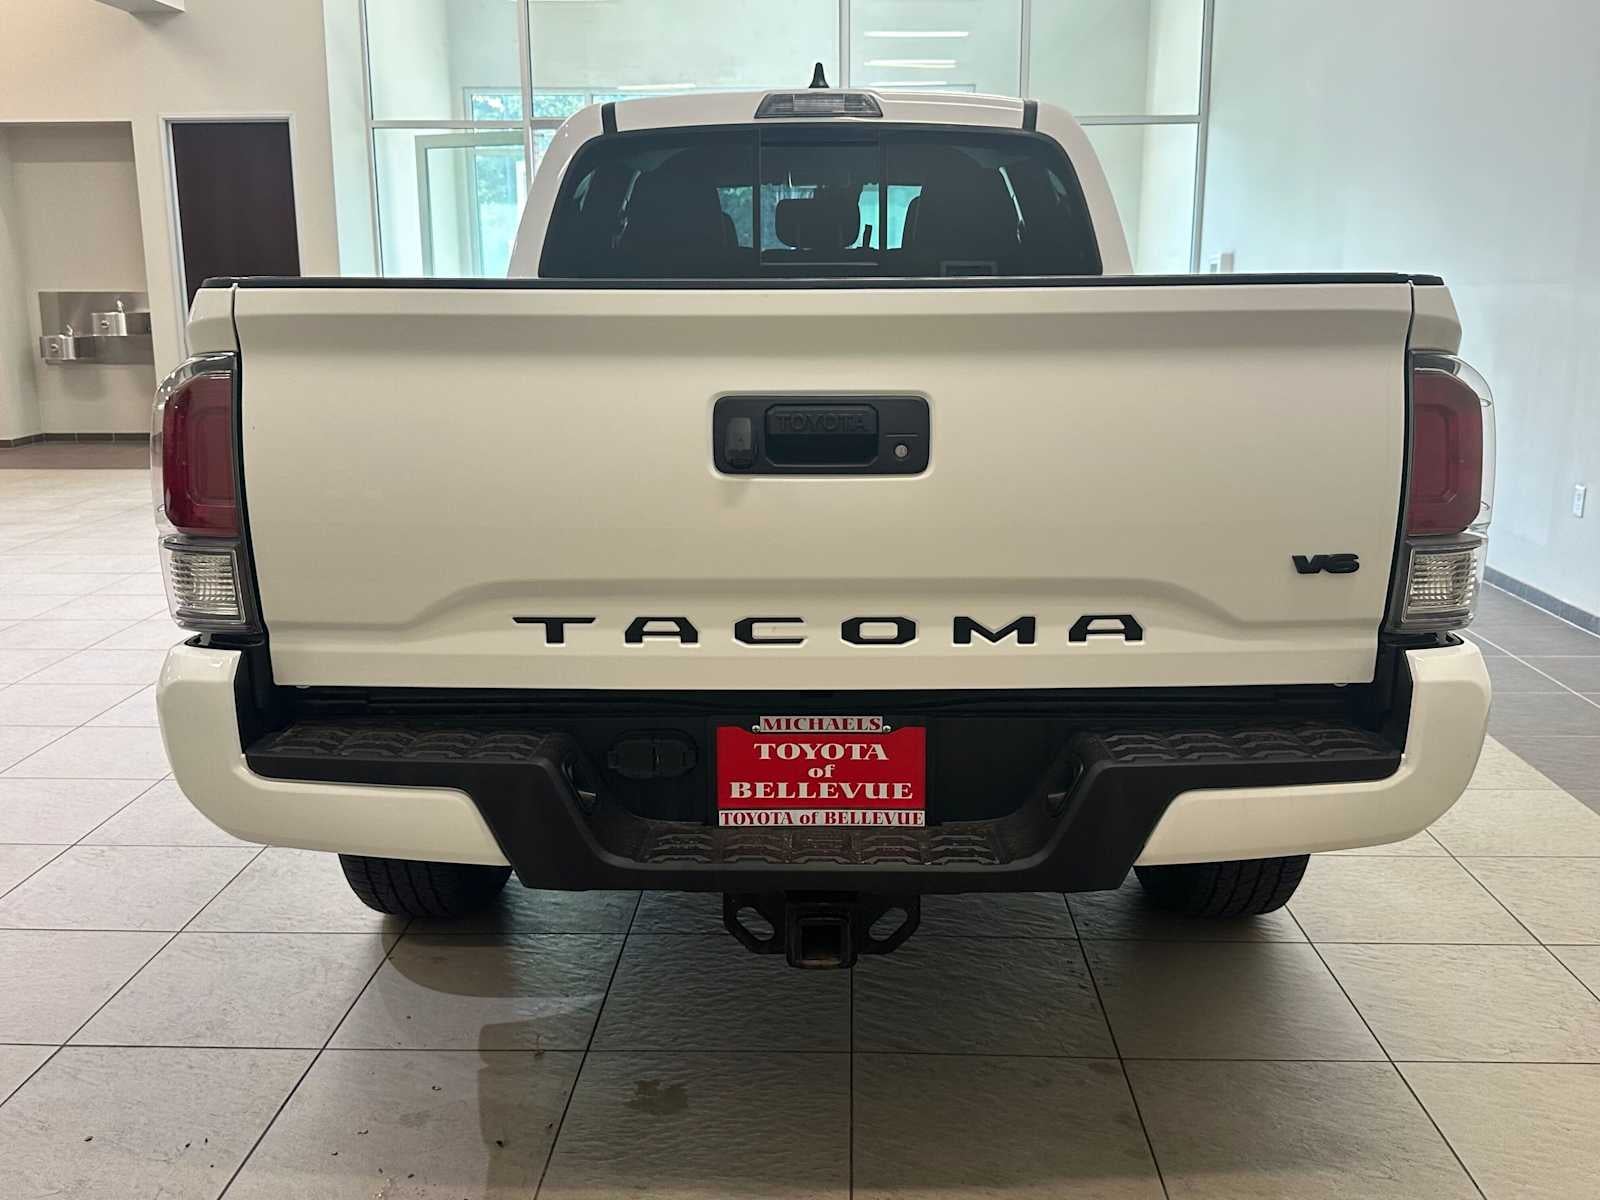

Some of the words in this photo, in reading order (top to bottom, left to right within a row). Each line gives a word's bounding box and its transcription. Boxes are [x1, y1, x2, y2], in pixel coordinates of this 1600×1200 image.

[776, 414, 866, 432] TOYOTA
[1292, 553, 1360, 575] V6
[513, 614, 1145, 646] TACOMA
[763, 717, 881, 731] MICHAELS
[753, 743, 889, 760] TOYOTA
[807, 764, 836, 778] of
[729, 781, 913, 799] BELLEVUE
[720, 811, 793, 825] TOYOTA
[799, 811, 819, 825] of
[823, 811, 924, 825] BELLEVUE
